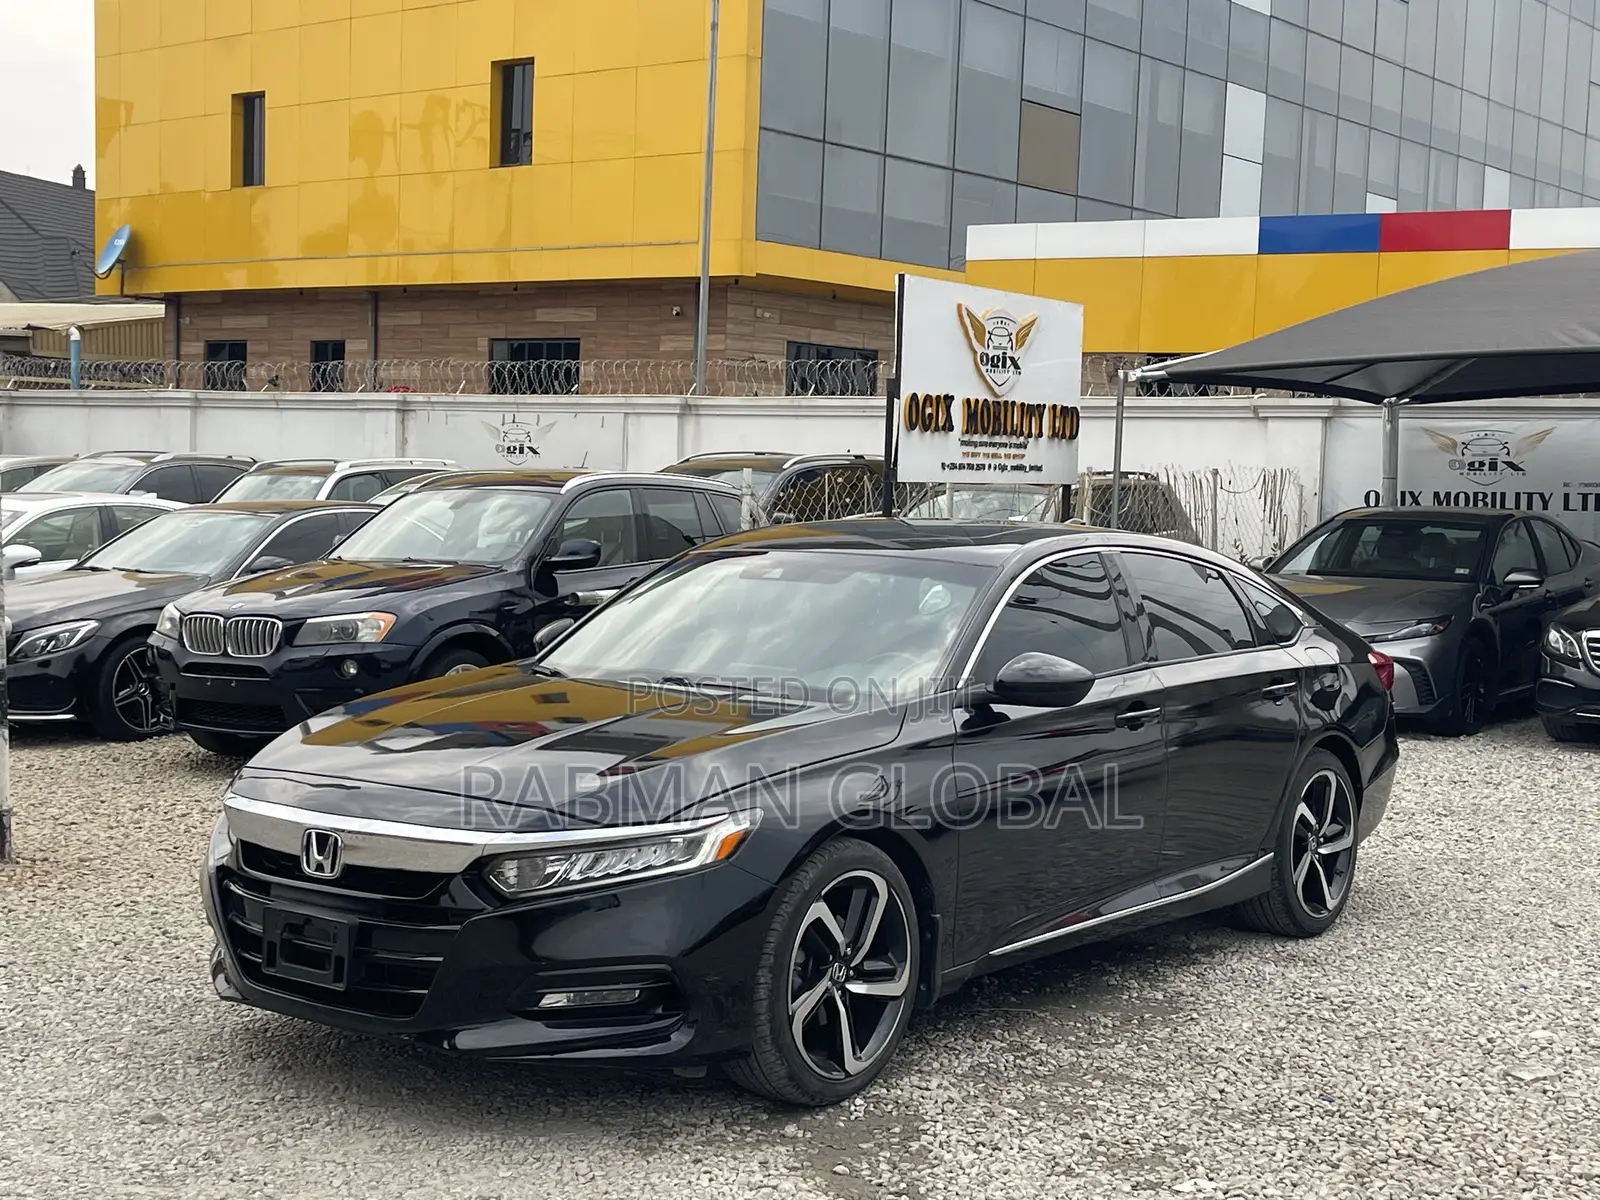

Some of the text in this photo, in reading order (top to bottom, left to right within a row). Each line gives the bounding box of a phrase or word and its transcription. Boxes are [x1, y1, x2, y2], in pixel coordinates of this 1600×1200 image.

[904, 392, 1080, 441] OGIX MOBILITY LTD
[1364, 489, 1422, 508] OIX
[1432, 490, 1554, 511] MOBILITY
